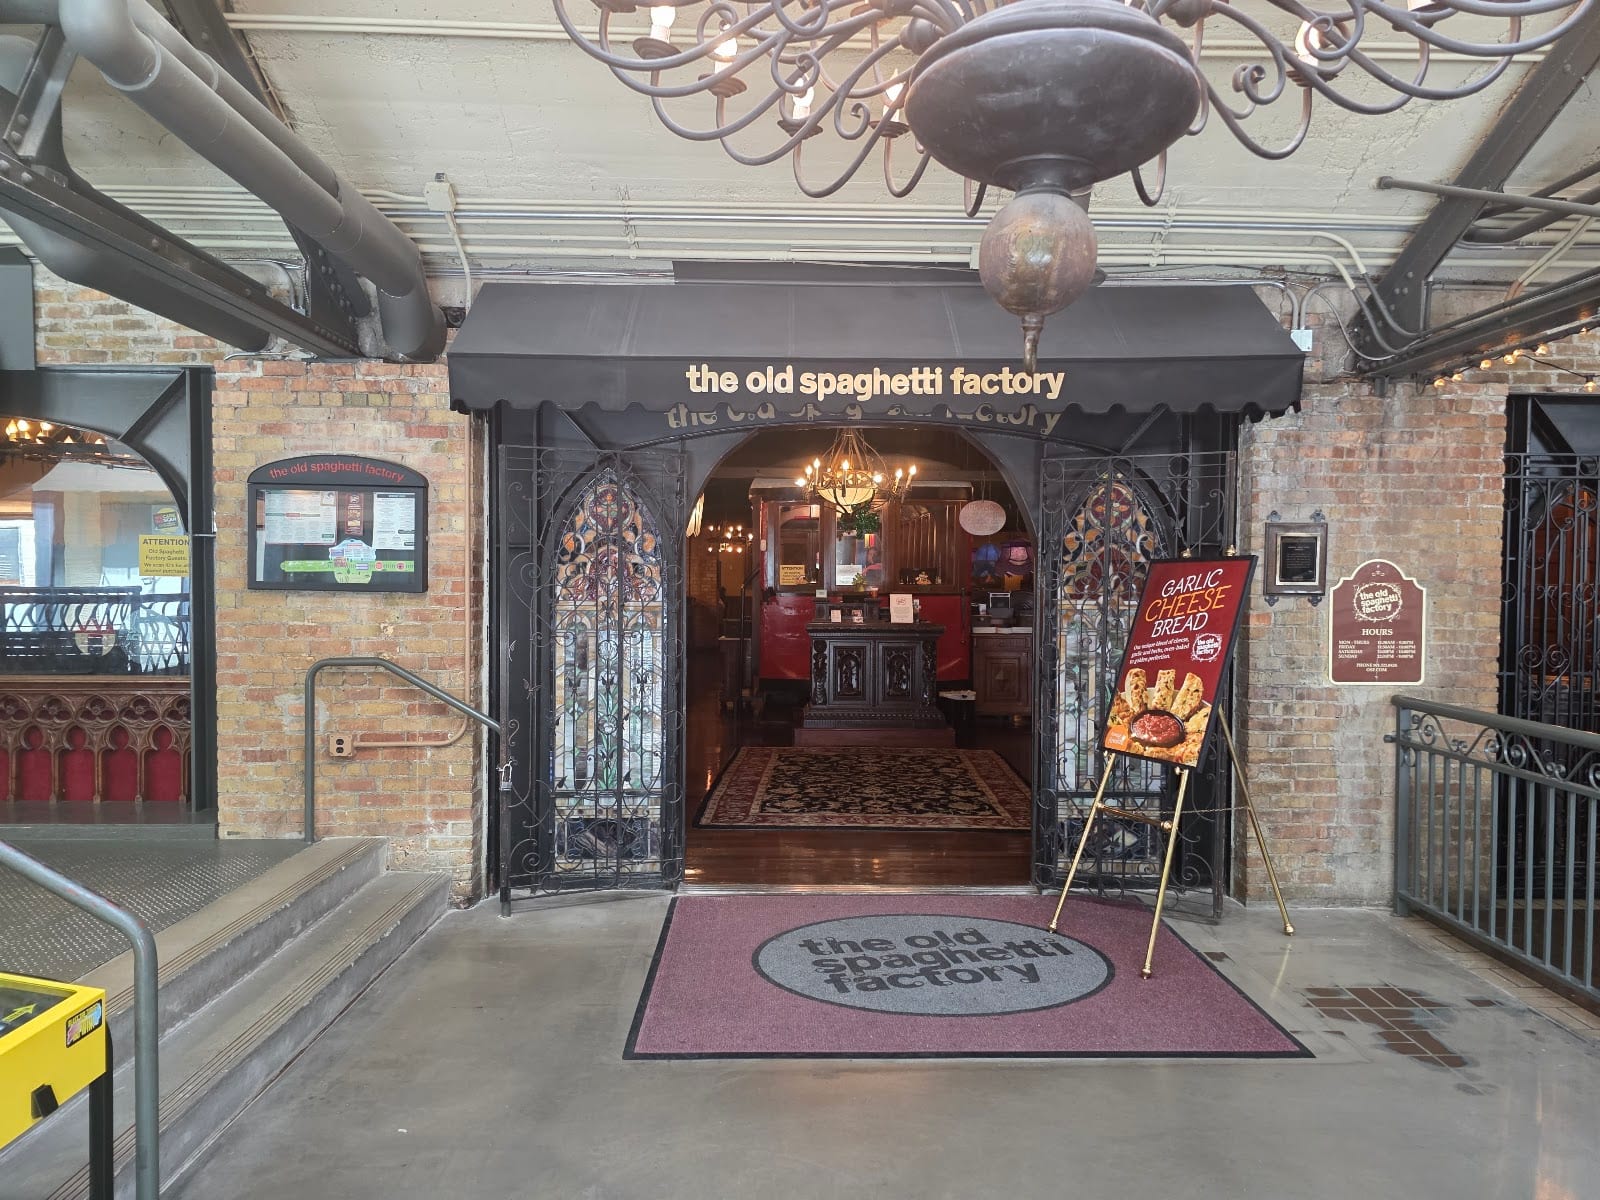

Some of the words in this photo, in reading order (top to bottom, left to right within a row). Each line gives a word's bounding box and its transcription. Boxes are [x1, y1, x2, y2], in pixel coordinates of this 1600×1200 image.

[686, 364, 739, 393] the
[746, 365, 793, 394] old
[799, 367, 942, 401] spaghetti
[950, 367, 1064, 400] factory
[269, 468, 288, 479] the
[290, 462, 307, 473] old
[310, 461, 362, 473] spaghetti
[365, 463, 405, 482] factory
[143, 538, 189, 546] ATTENTION
[1161, 568, 1224, 598] GARLIC
[1360, 592, 1374, 600] the
[1375, 589, 1388, 598] old
[1145, 585, 1232, 622] CHEESE
[1361, 594, 1398, 607] spaghetti
[1362, 603, 1392, 613] factory
[1151, 612, 1209, 638] BREAD
[1362, 628, 1393, 636] HOURS
[798, 936, 896, 956] the
[904, 928, 991, 949] old
[812, 938, 1075, 975] spaghetti
[824, 962, 1041, 994] factory
